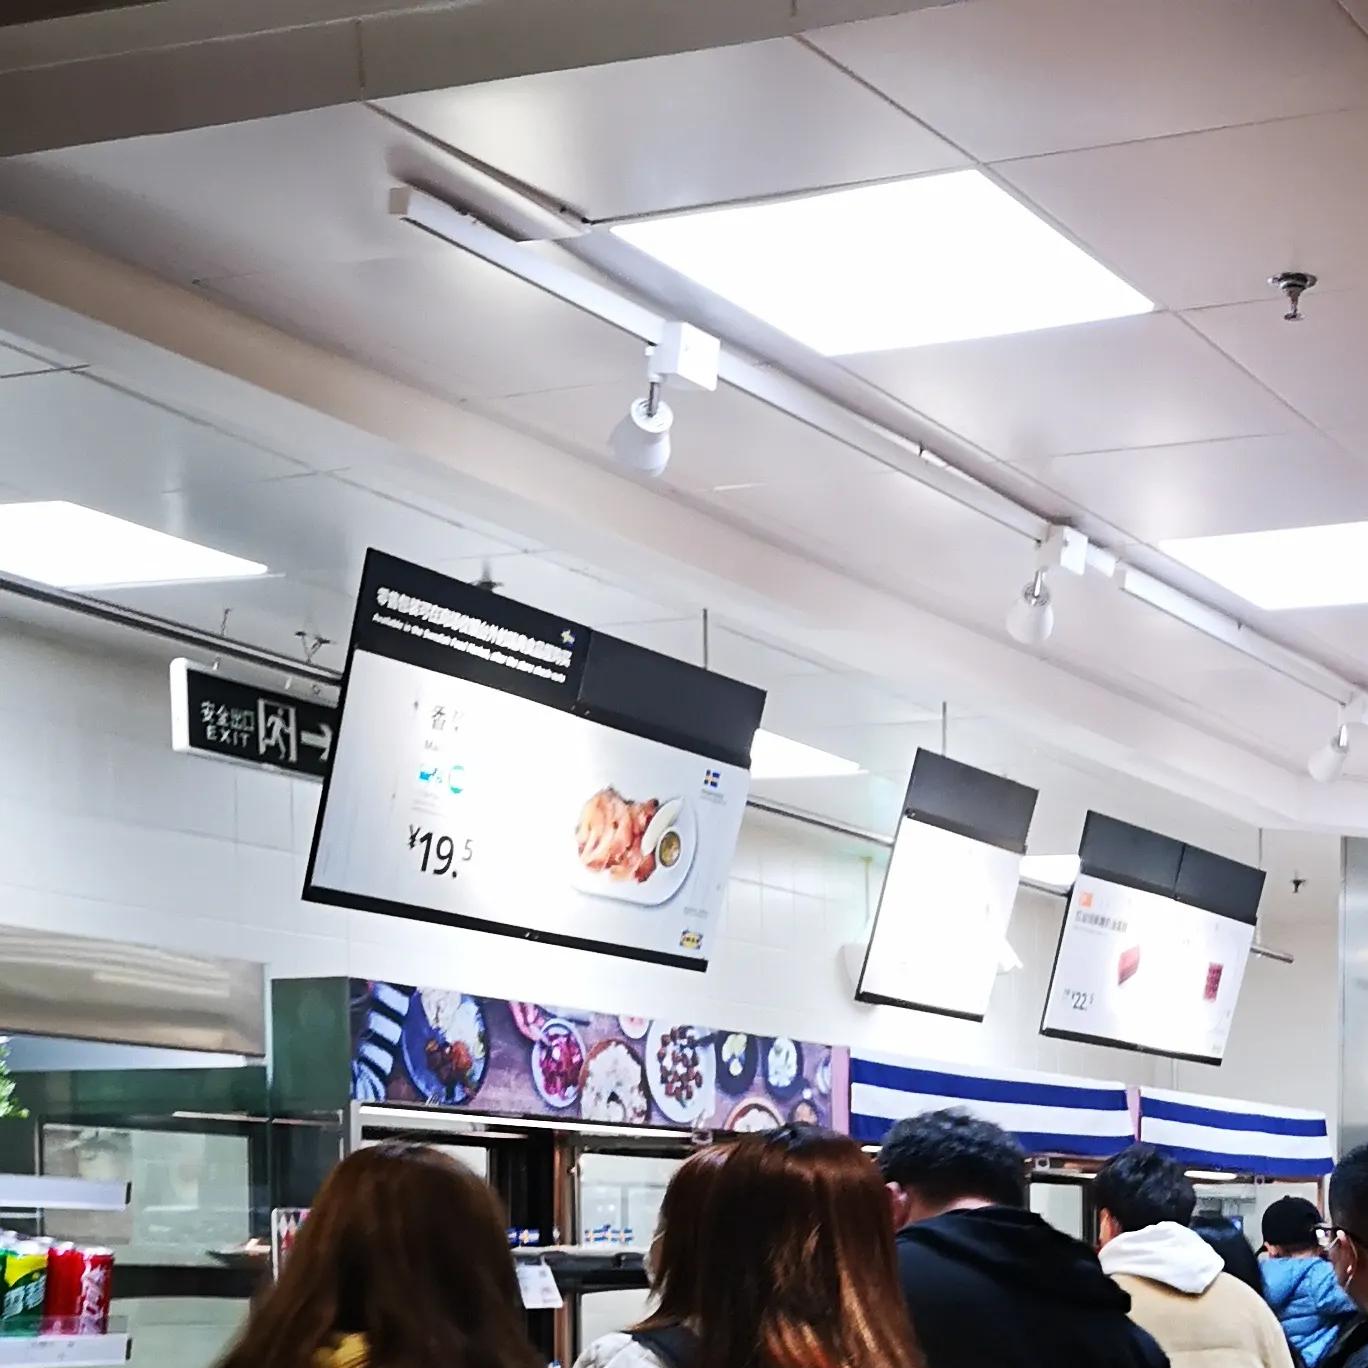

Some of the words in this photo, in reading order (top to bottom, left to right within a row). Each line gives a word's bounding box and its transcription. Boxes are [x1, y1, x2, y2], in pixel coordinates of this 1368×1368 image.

[200, 701, 255, 732] 安全出口
[206, 724, 250, 748] EXIT
